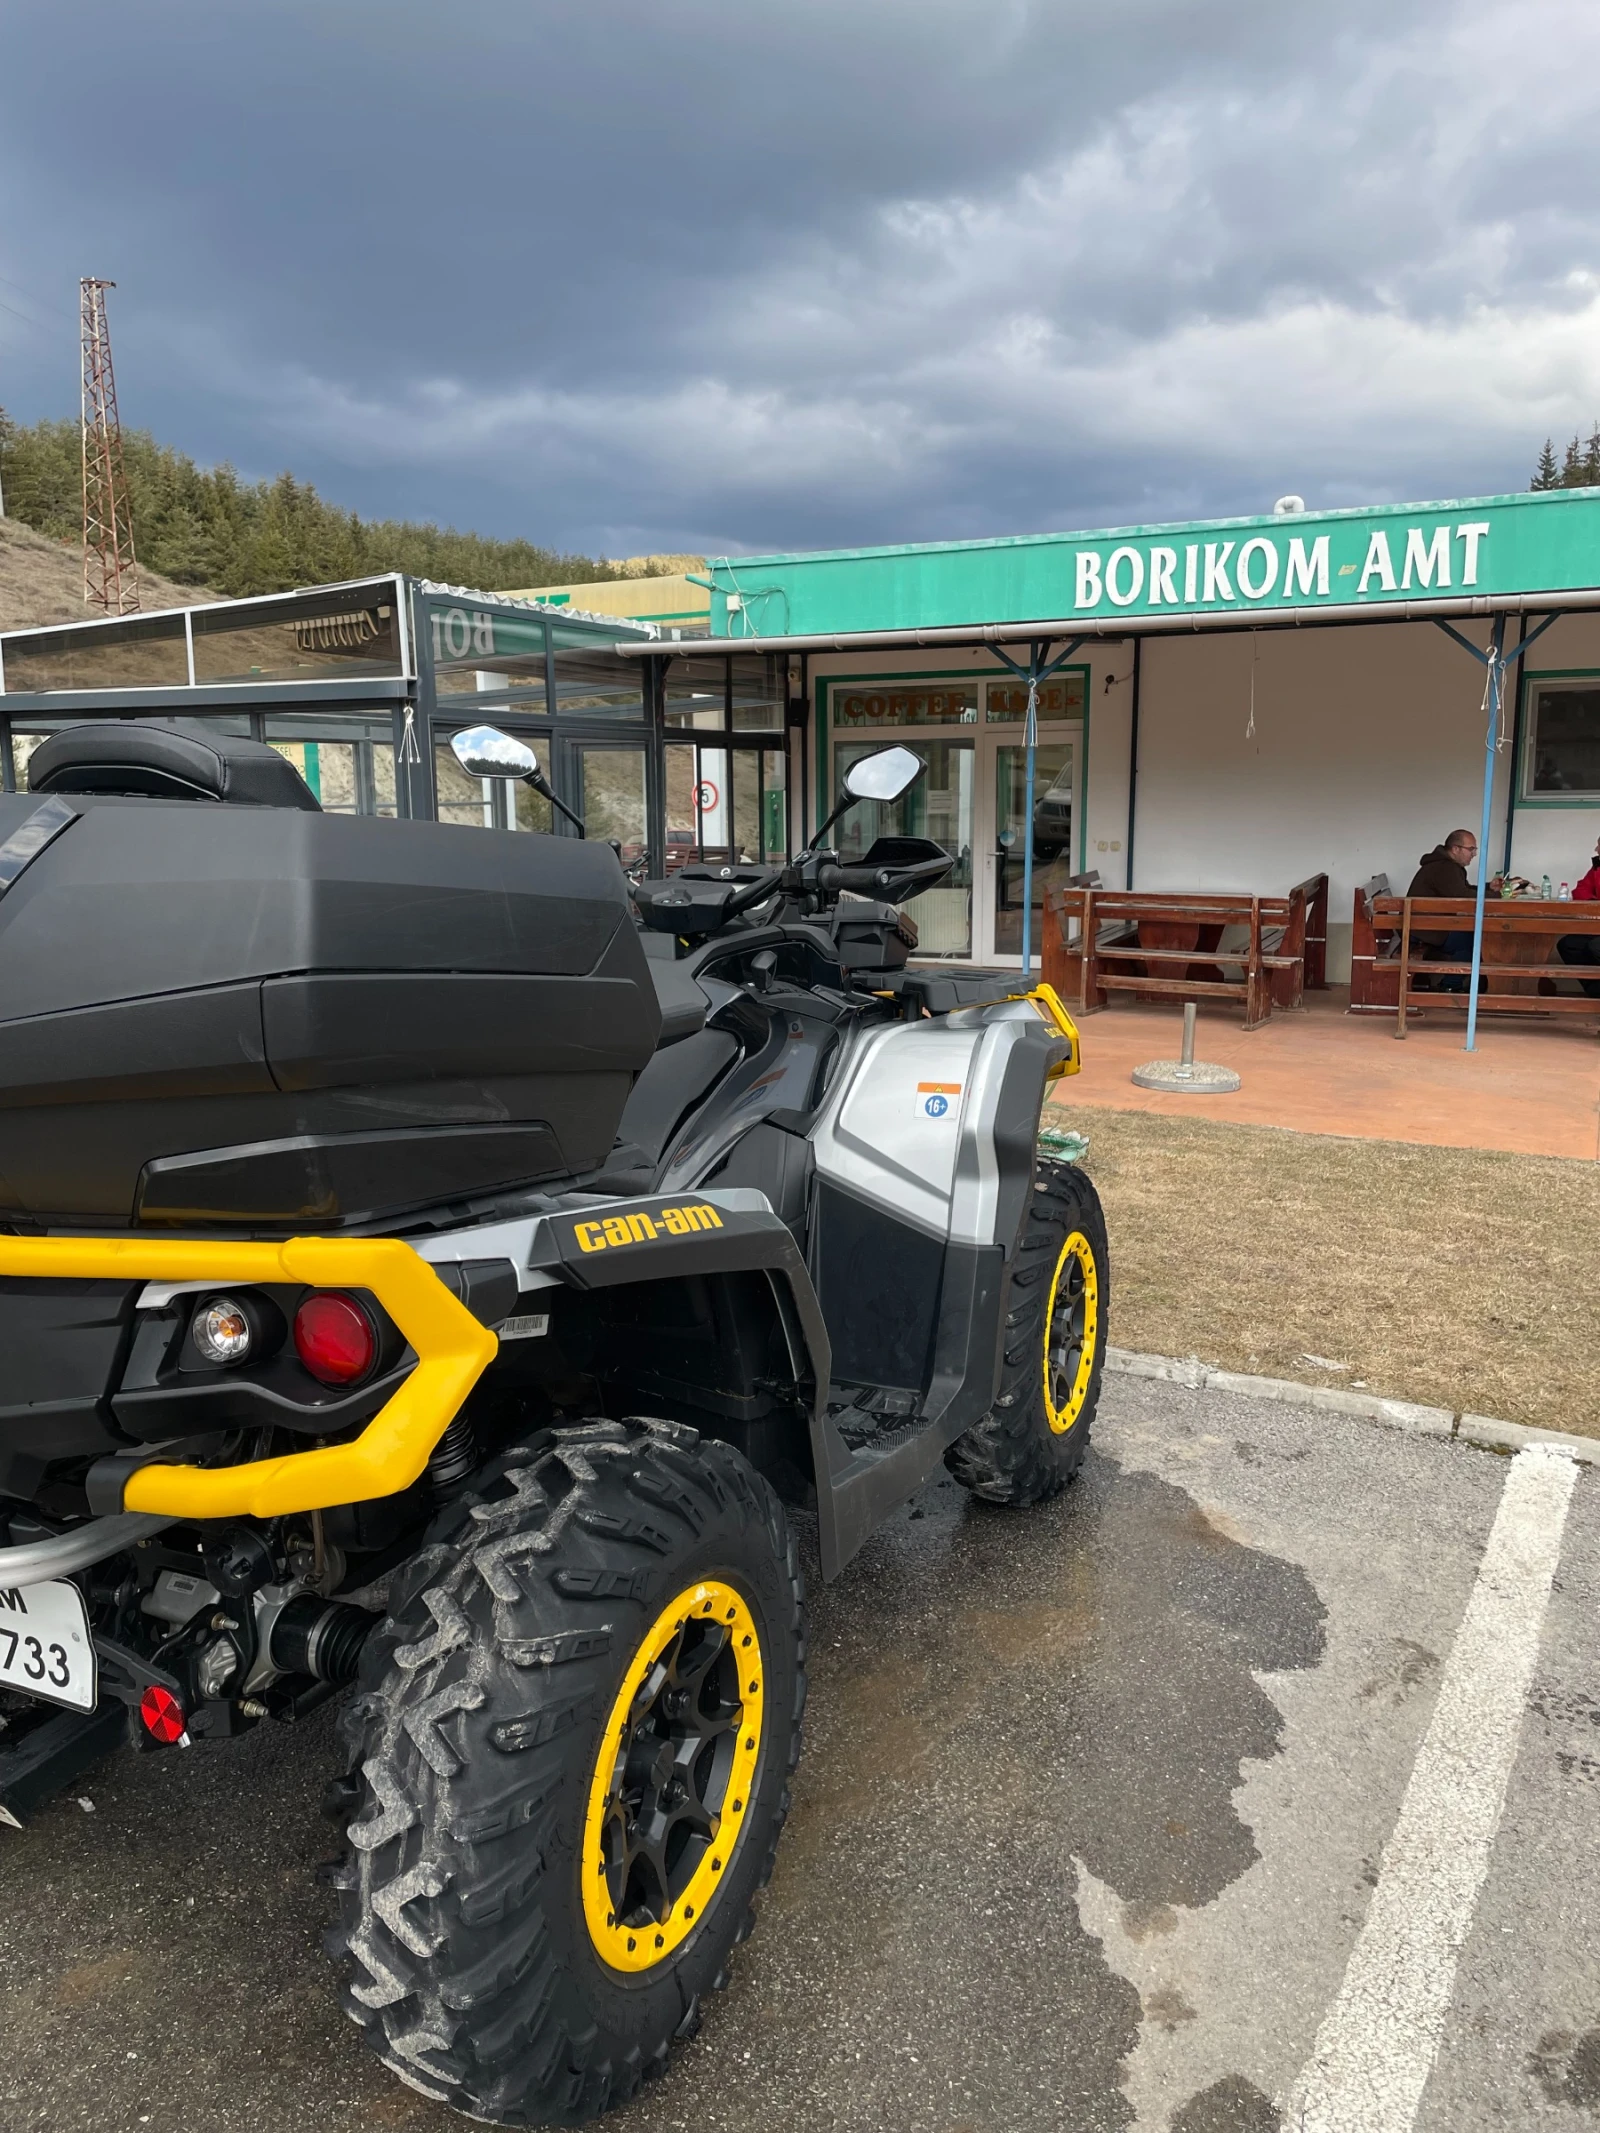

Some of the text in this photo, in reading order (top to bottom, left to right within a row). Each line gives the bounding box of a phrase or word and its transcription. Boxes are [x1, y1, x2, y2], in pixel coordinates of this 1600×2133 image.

[1073, 522, 1491, 609] BORIKOM AMT
[844, 692, 967, 718] COFFEE
[927, 1099, 946, 1114] 16+
[573, 1204, 724, 1253] can-am
[0, 1626, 71, 1688] 733
